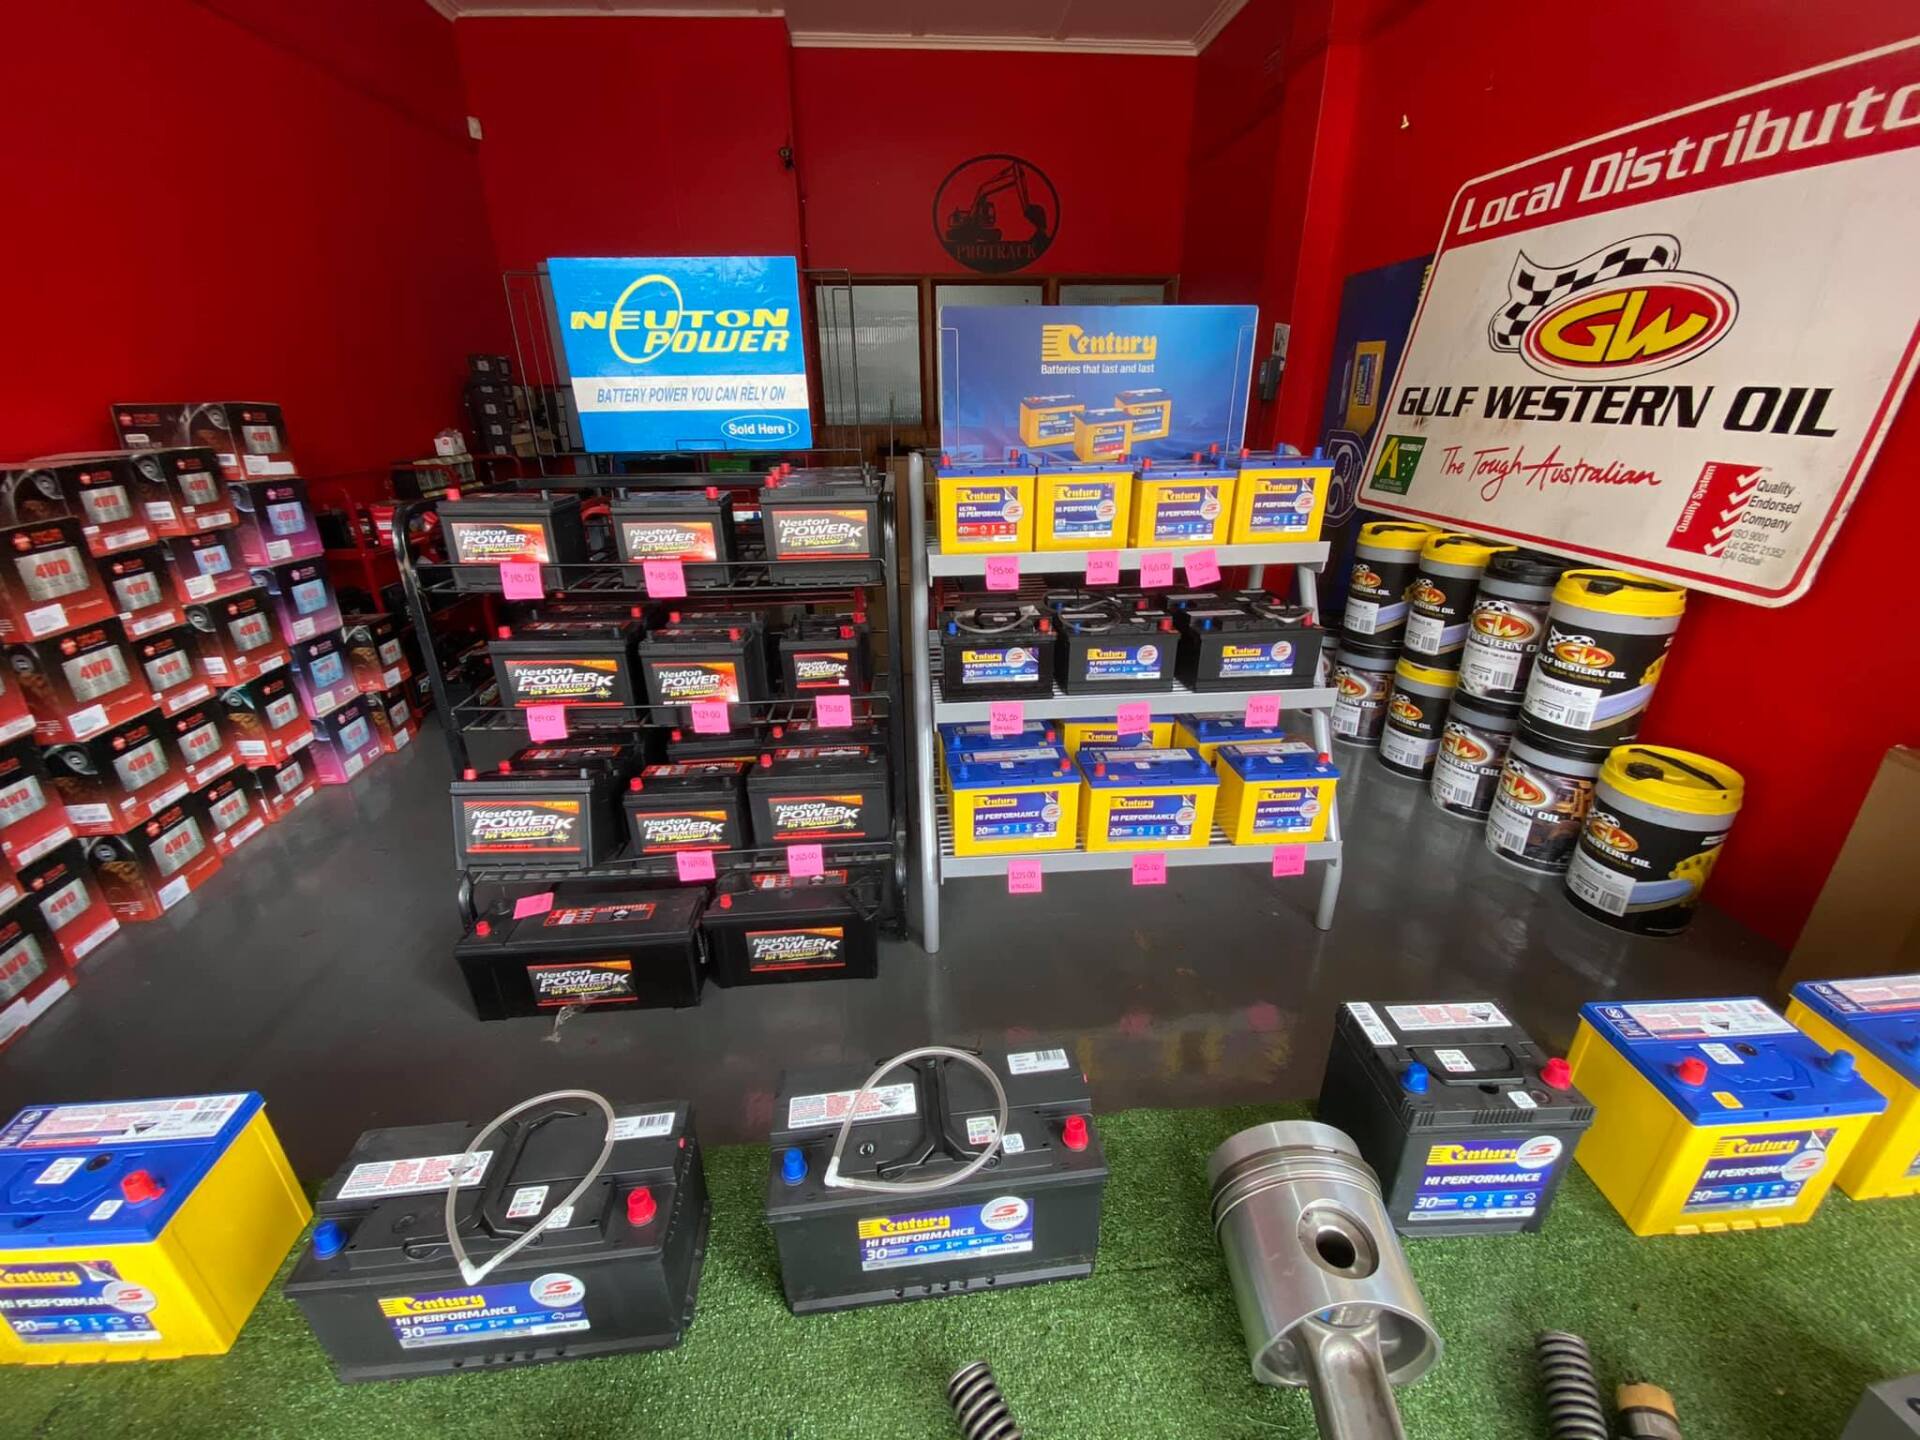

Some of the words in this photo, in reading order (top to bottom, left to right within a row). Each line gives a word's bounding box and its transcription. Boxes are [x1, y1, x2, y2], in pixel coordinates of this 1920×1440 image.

[1457, 174, 1568, 236] Local
[570, 308, 790, 330] NEUTON
[643, 330, 790, 353] POWER
[1041, 324, 1157, 361] Century
[1041, 364, 1080, 374] Batteries
[1082, 364, 1100, 374] that
[1102, 364, 1118, 374] last
[1120, 364, 1137, 374] and
[1138, 364, 1154, 374] last
[596, 388, 647, 403] BATTERY
[648, 388, 688, 402] POWER
[691, 388, 714, 402] YOU
[715, 387, 739, 401] CAN
[740, 386, 768, 400] RELY
[770, 386, 786, 400] ON
[1396, 386, 1480, 416] GULF
[1484, 385, 1712, 428] WESTERN
[1723, 386, 1838, 438] OIL
[728, 423, 756, 435] Sold
[757, 422, 784, 434] Here
[1440, 446, 1466, 476] The
[1468, 444, 1523, 501] Tough
[1522, 444, 1662, 487] Australian
[1055, 487, 1102, 500] Century
[1256, 480, 1298, 494] Century
[1756, 480, 1796, 498] Quality
[956, 488, 1000, 502] Century
[1158, 490, 1200, 502] Century
[1676, 500, 1701, 533] Quality
[1692, 465, 1718, 500] System
[1748, 496, 1802, 514] Endorsed
[779, 518, 830, 528] Neuton
[1740, 512, 1792, 533] Company
[630, 529, 677, 538] Neuton
[34, 558, 71, 578] 4WD
[962, 650, 1002, 663] Century
[1087, 648, 1126, 660] Century
[1222, 646, 1261, 657] Century
[80, 658, 113, 680] 4WD
[514, 668, 574, 678] Neuton
[659, 670, 702, 680] Neuton
[1554, 660, 1606, 678] WESTERN
[1608, 671, 1626, 680] OIL
[128, 752, 154, 772] 4WD
[1111, 796, 1154, 809] Century
[1259, 790, 1301, 801] Century
[776, 803, 826, 812] Neuton
[974, 797, 1017, 809] Century
[471, 810, 534, 820] Neuton
[984, 811, 1040, 820] PERFORMANCE
[643, 818, 691, 828] Neuton
[164, 830, 191, 857] 4WD
[50, 890, 76, 915] 4WD
[752, 936, 804, 946] Neuton
[536, 969, 591, 980] Neuton
[1709, 1138, 1798, 1160] Century
[1424, 1176, 1440, 1186] HI
[1440, 1172, 1542, 1185] PERFORMANCE
[1702, 1170, 1718, 1180] HI
[1414, 1197, 1439, 1209] 30
[1689, 1190, 1712, 1202] 30
[858, 1216, 950, 1240] Century
[866, 1238, 881, 1248] HI
[881, 1227, 976, 1246] PERFORMANCE
[866, 1249, 888, 1262] 30
[379, 1294, 485, 1318] Century
[396, 1318, 412, 1326] HI
[413, 1306, 518, 1324] PERFORMANCE
[13, 1320, 38, 1333] 20
[401, 1326, 424, 1340] 30
